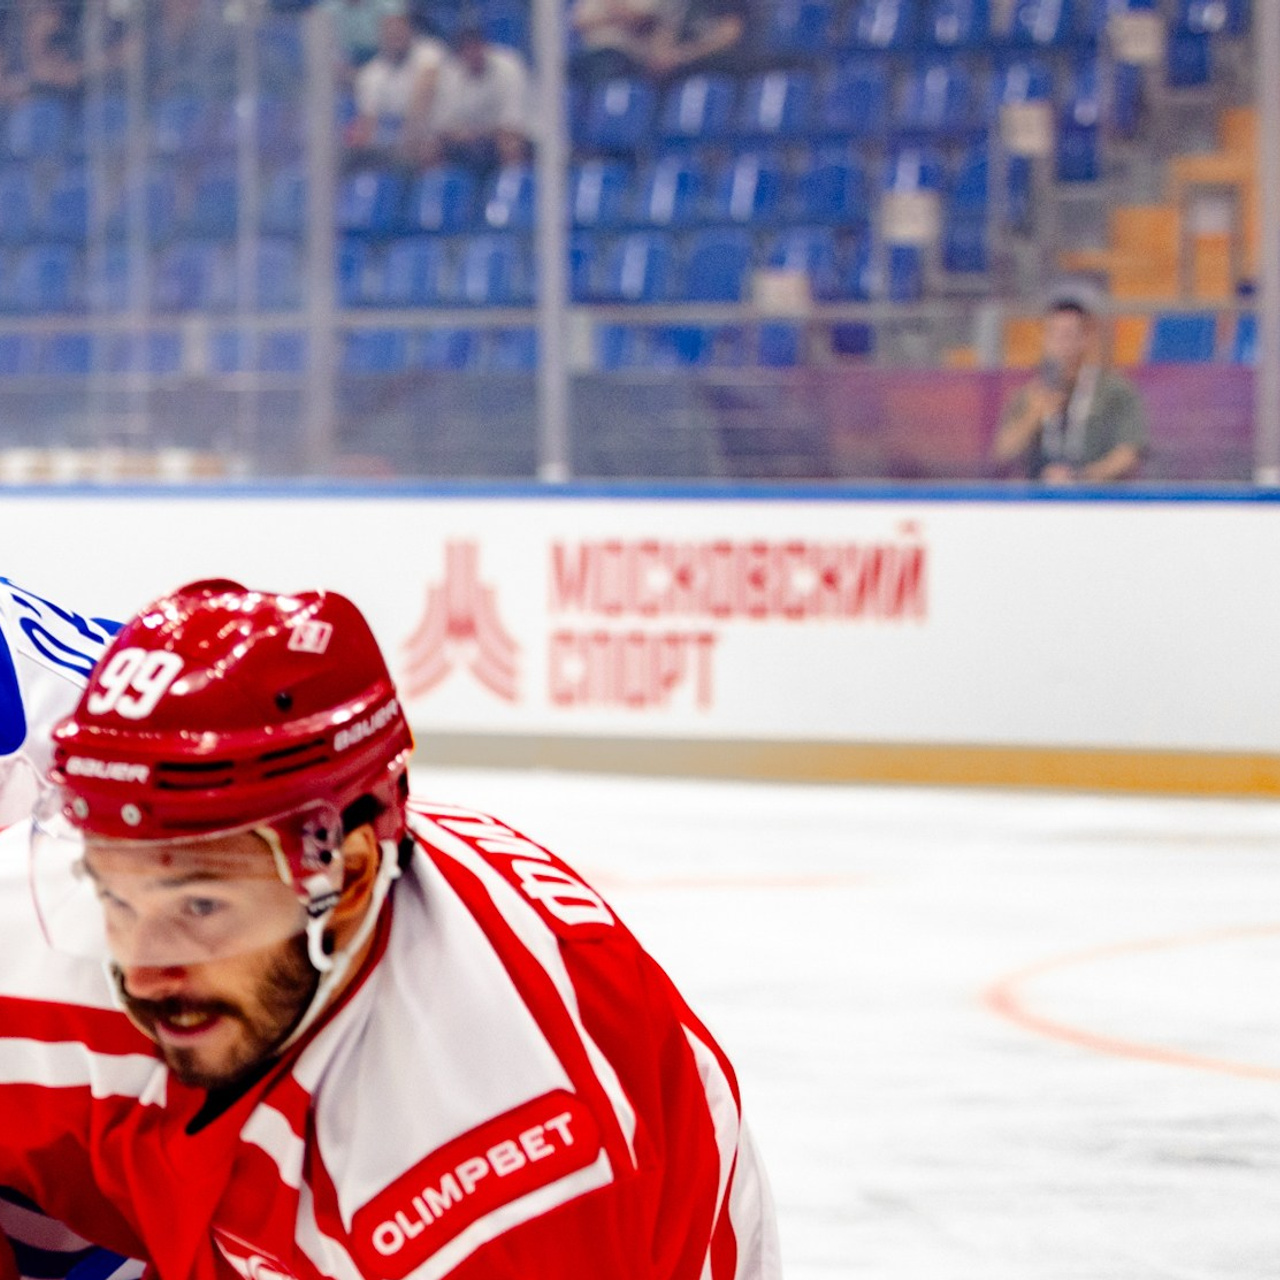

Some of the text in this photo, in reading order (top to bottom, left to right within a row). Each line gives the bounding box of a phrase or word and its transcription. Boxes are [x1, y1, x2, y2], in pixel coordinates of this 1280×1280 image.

[549, 519, 927, 621] МОСКОВСКИЙ
[87, 647, 184, 720] 99
[549, 630, 717, 712] СПОРТ
[371, 1112, 575, 1256] OLIMPBET
